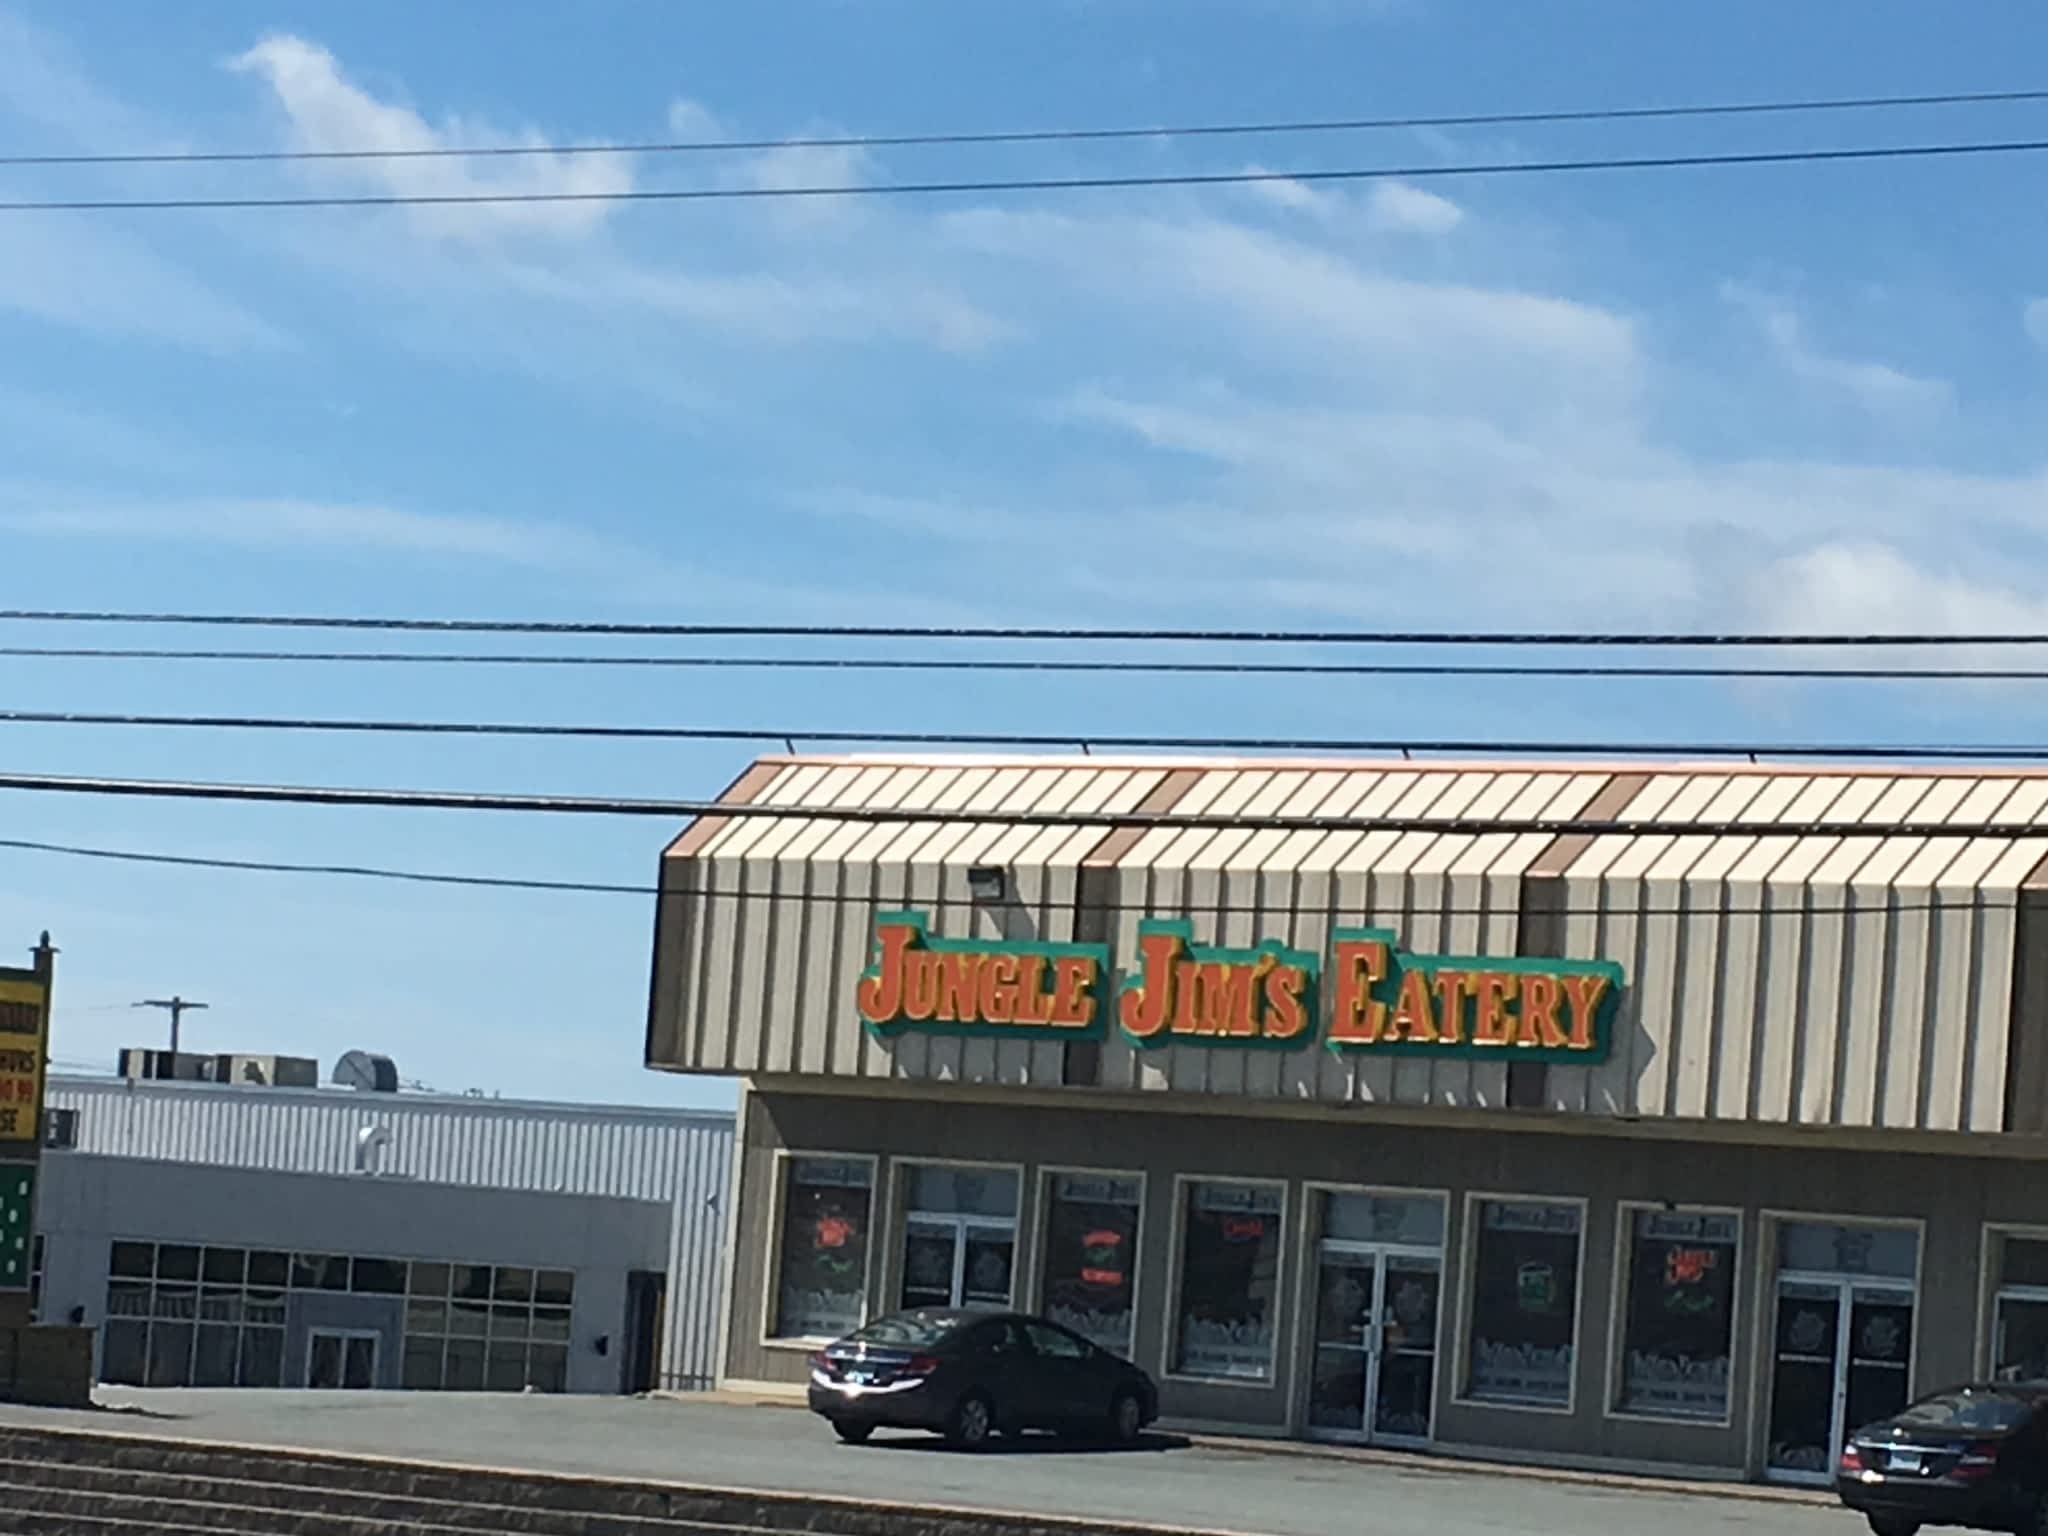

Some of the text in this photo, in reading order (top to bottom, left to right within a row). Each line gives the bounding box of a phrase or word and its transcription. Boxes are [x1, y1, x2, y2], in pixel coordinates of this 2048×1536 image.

[858, 925, 1610, 1050] JUNGLE JIM'S EATERY
